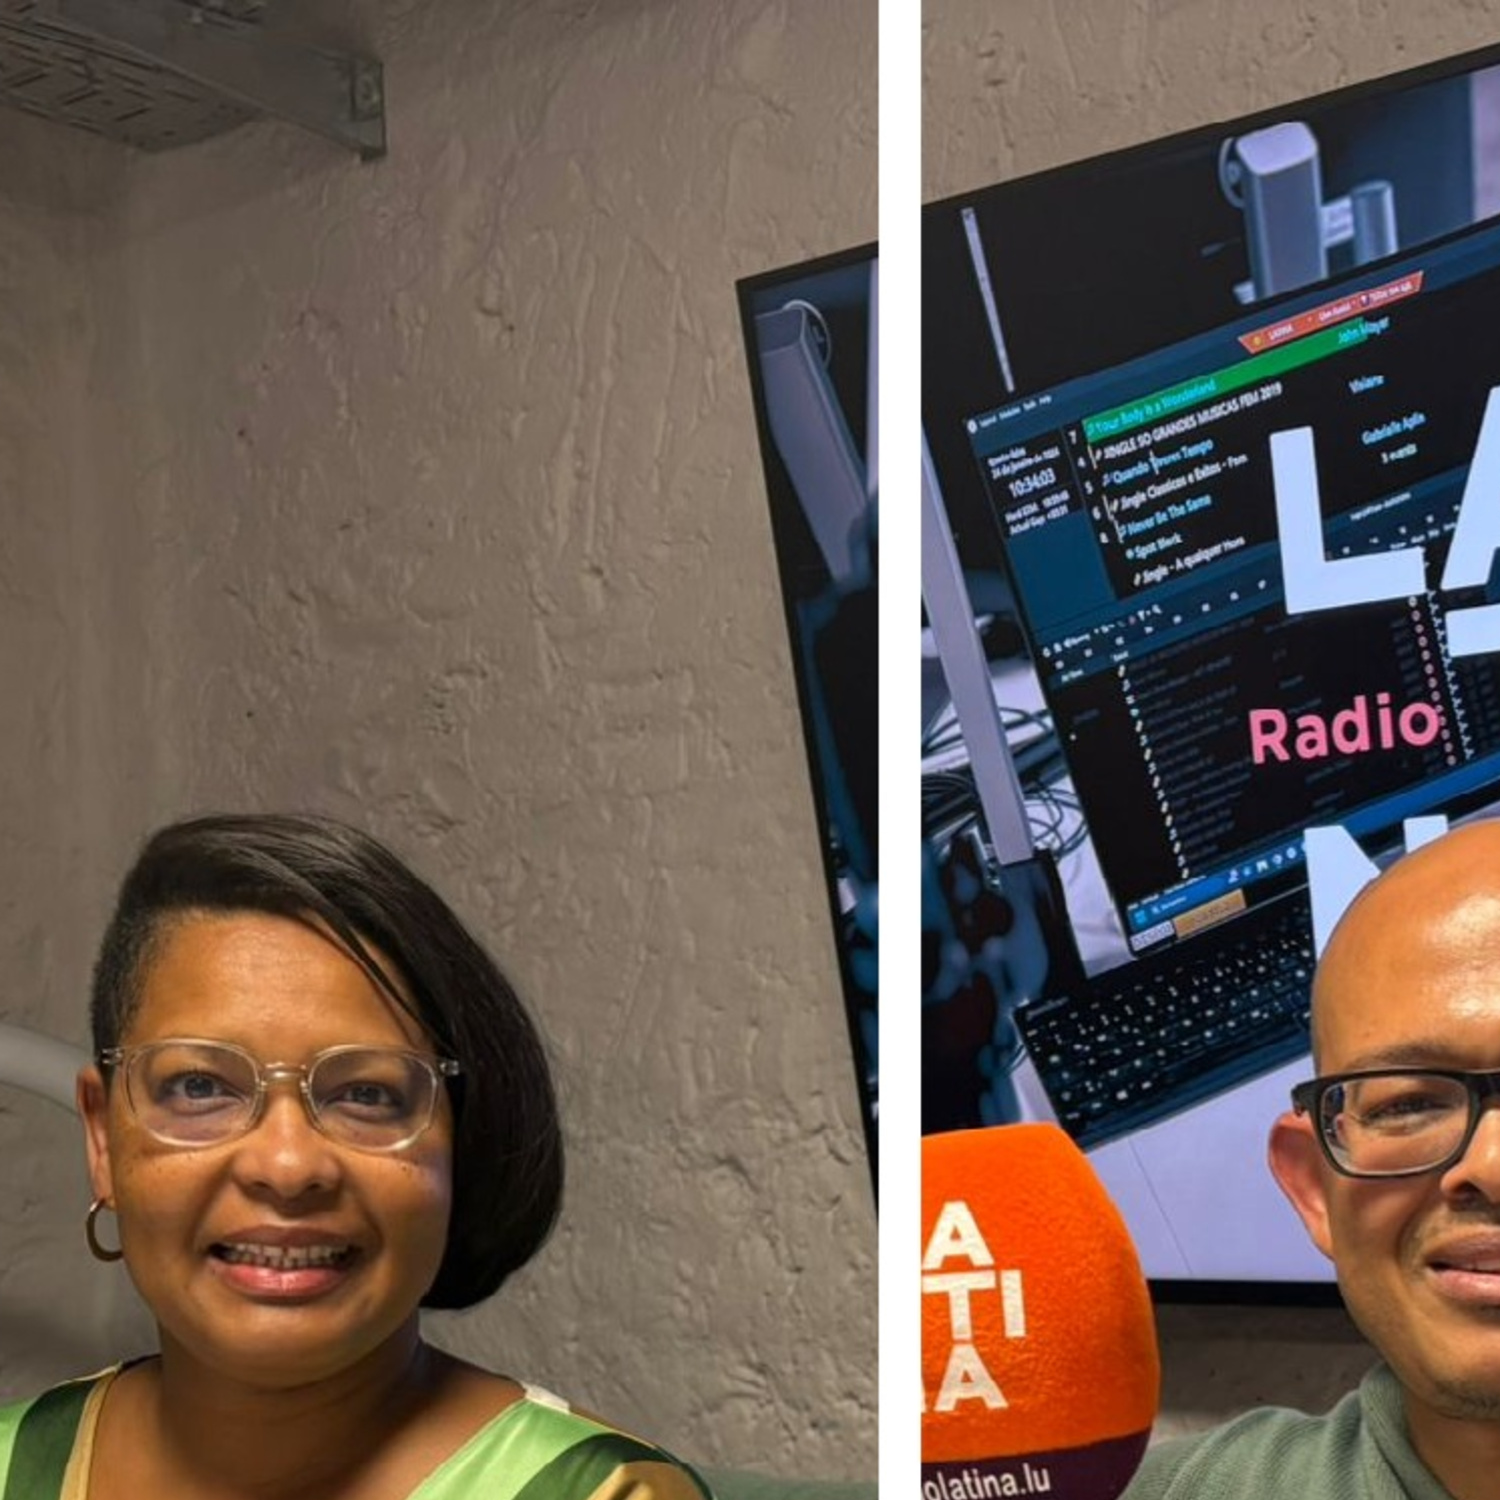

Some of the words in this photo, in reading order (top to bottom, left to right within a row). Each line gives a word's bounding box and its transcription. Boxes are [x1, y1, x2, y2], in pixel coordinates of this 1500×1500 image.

[1152, 416, 1198, 441] GRANDES
[1009, 468, 1057, 498] 10:34:03
[1168, 502, 1186, 518] The
[1249, 691, 1442, 765] Radio
[921, 1269, 1027, 1341] TI
